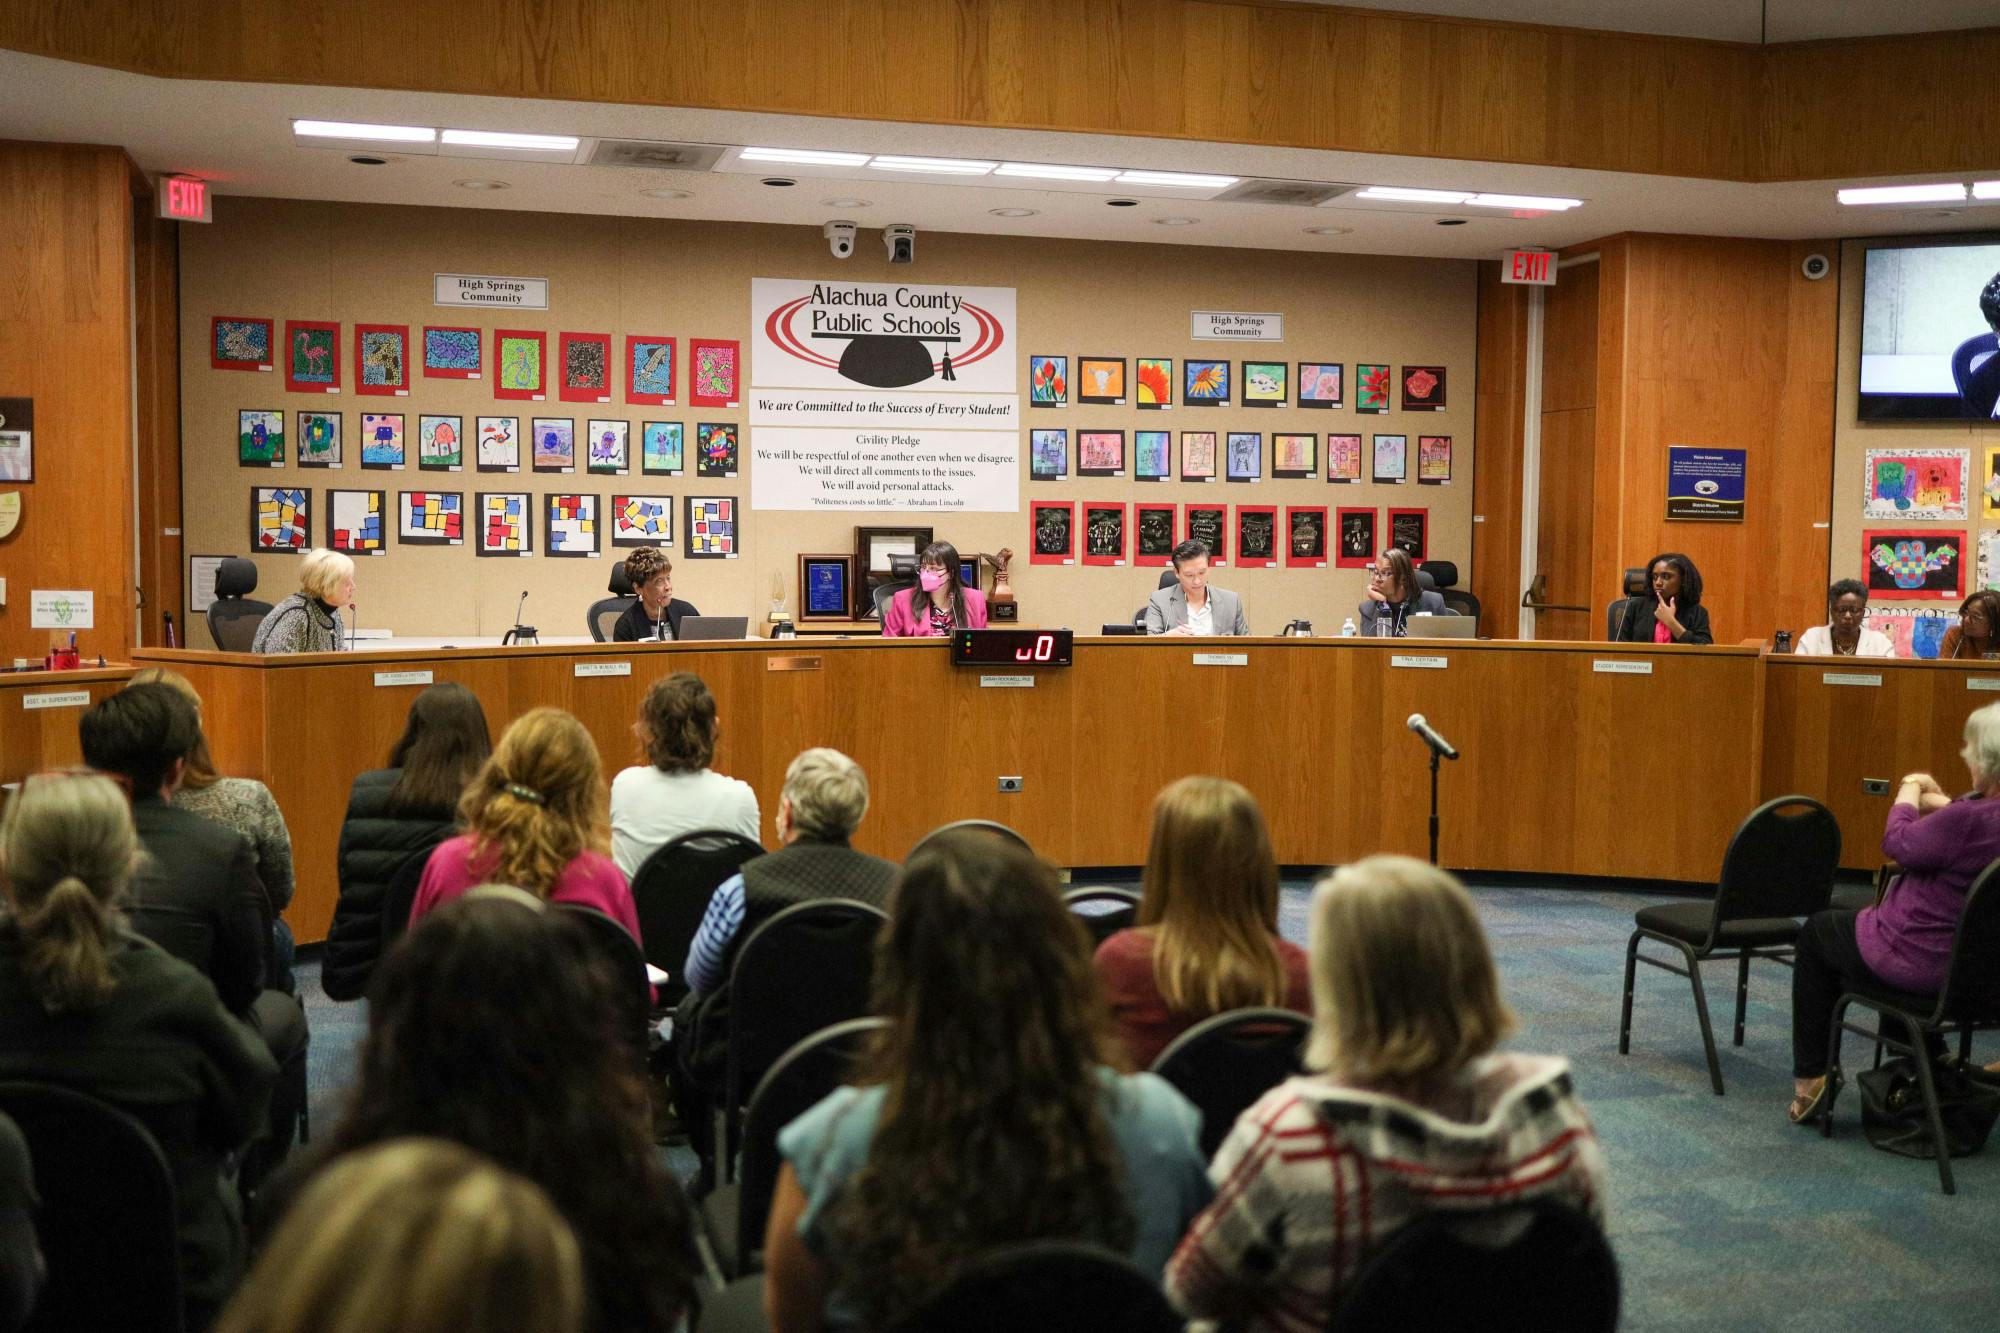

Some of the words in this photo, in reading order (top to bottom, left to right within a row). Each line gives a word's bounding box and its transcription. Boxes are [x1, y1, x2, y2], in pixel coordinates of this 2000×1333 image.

[168, 179, 205, 219] EXIT
[1512, 251, 1552, 281] EXIT
[458, 279, 484, 290] High
[487, 280, 525, 292] Springs
[461, 291, 522, 304] Community
[810, 283, 888, 307] Alachua
[895, 289, 962, 314] County
[811, 310, 872, 333] Public
[883, 312, 960, 335] Schools
[1211, 315, 1232, 326] High
[1234, 316, 1265, 326] Springs
[1213, 326, 1262, 337] Community
[759, 400, 773, 410] We
[796, 401, 853, 411] Committed
[856, 403, 865, 412] to
[869, 402, 884, 412] the
[887, 402, 922, 413] Success
[925, 403, 937, 416] of
[938, 404, 966, 417] Every
[969, 404, 1010, 415] Student!
[856, 435, 887, 447] Civility
[892, 436, 920, 447] Pledge
[758, 450, 771, 459] We
[774, 450, 790, 459] will
[793, 450, 803, 459] be
[806, 451, 848, 462] respectful
[881, 452, 914, 461] another
[939, 453, 961, 462] when
[978, 453, 1014, 465] disagree.
[800, 466, 812, 474] We
[816, 466, 831, 474] will
[834, 466, 858, 475] direct
[862, 467, 872, 475] all
[933, 468, 946, 476] the
[822, 481, 835, 489] We
[839, 481, 853, 489] will
[857, 482, 880, 490] avoid
[883, 482, 919, 492] personal
